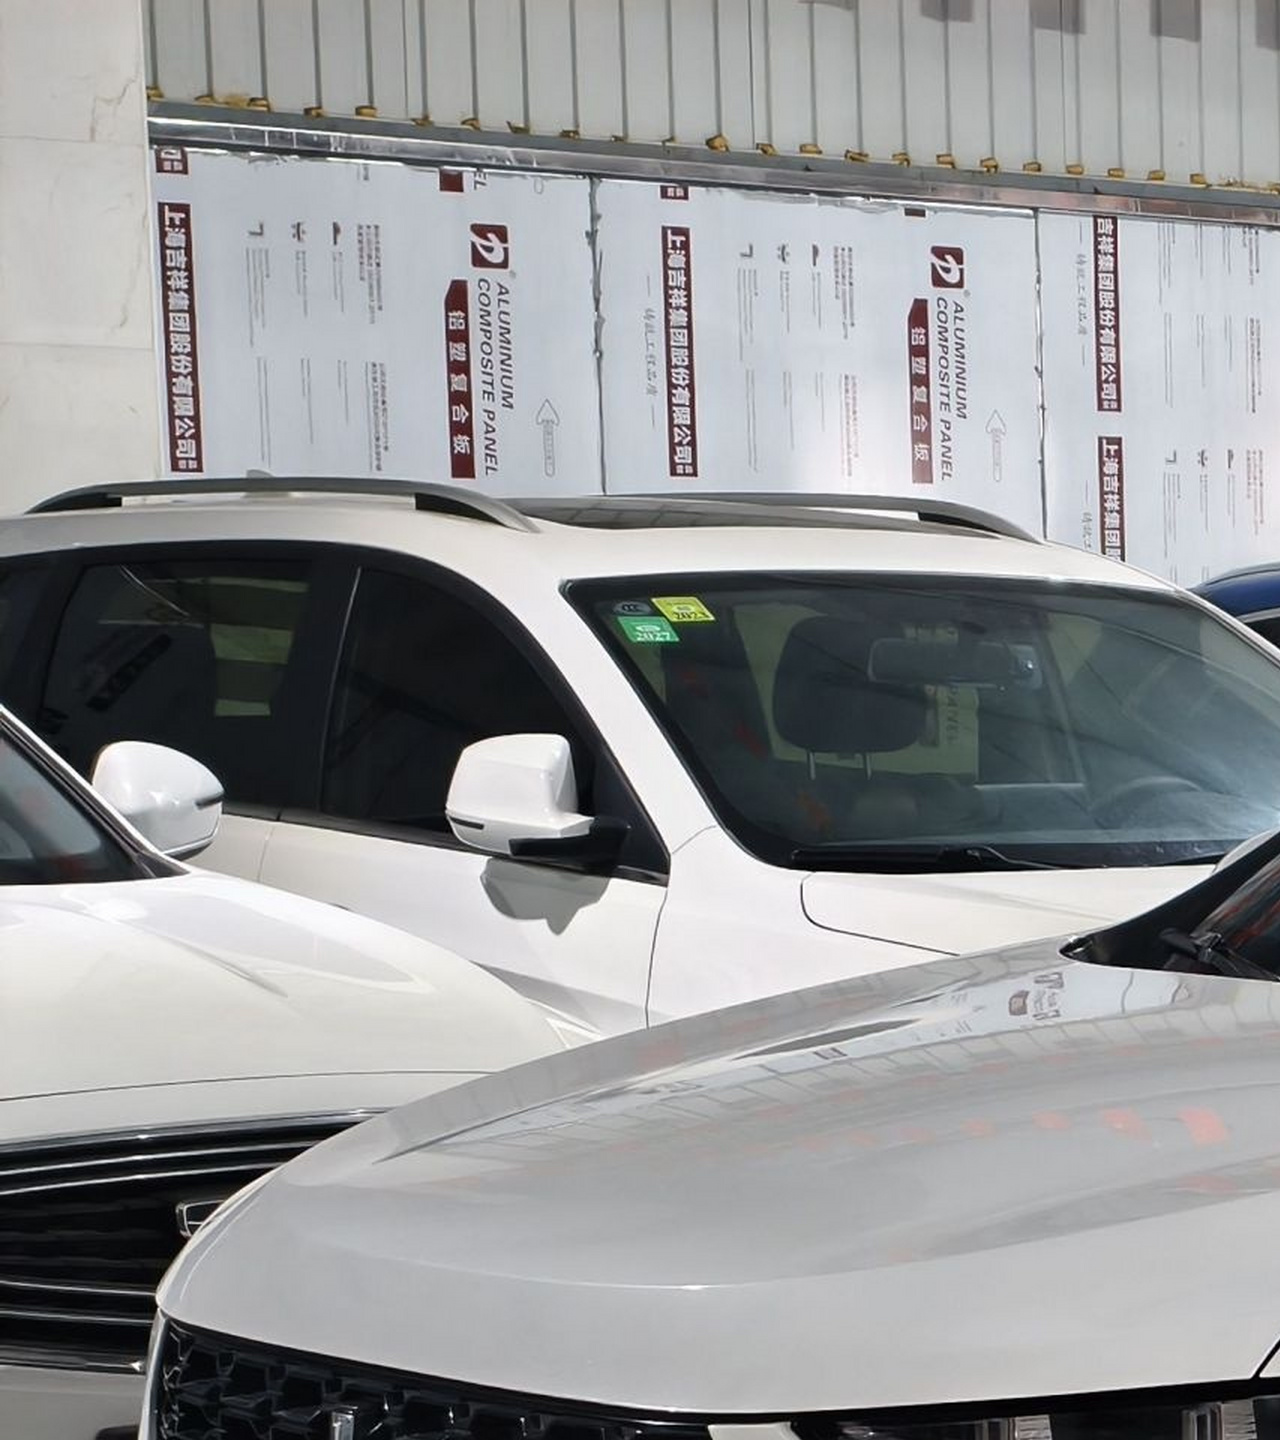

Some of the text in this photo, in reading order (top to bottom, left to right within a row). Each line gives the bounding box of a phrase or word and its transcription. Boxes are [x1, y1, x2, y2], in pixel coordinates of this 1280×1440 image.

[164, 204, 197, 460] 上海吉祥集团股份有限公司
[448, 310, 473, 455] 铝塑复合板
[477, 278, 498, 476] COMPOSITE PANEL
[496, 281, 515, 410] ALUMINIUM
[667, 231, 695, 463] 上海吉祥集团股份有限公司
[911, 326, 931, 462] 铝塑复合板
[935, 297, 952, 481] COMPOSITE PANEL
[951, 301, 968, 420] ALUMINIUM
